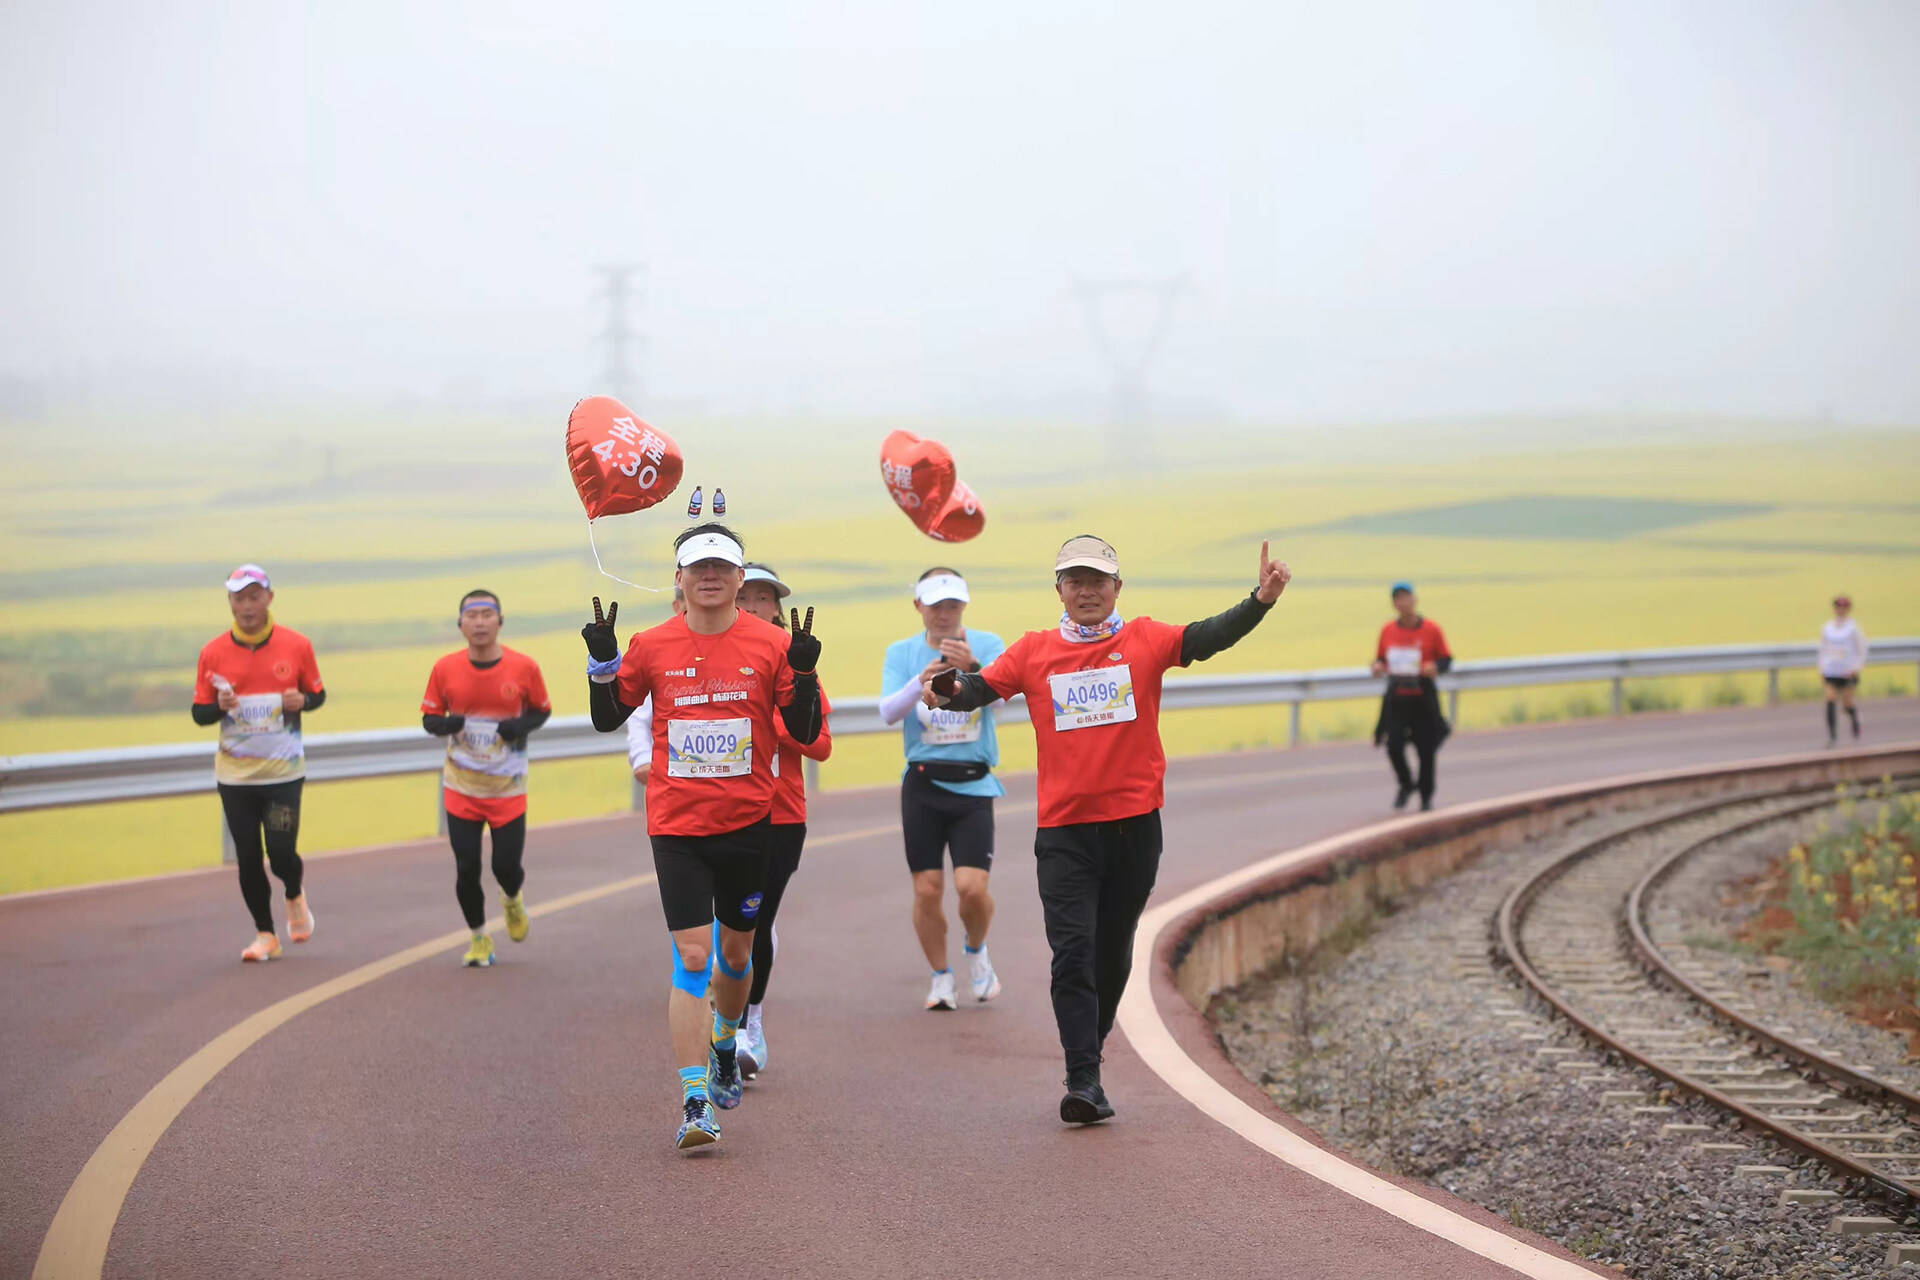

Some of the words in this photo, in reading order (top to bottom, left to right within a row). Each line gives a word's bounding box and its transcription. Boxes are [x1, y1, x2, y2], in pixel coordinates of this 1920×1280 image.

[608, 416, 666, 466] 全程
[592, 439, 658, 489] 4:30
[664, 680, 705, 698] Grand
[706, 678, 757, 693] Blossom
[712, 691, 748, 702] 畅游花海
[1067, 682, 1119, 706] A0496
[682, 734, 737, 754] A0029
